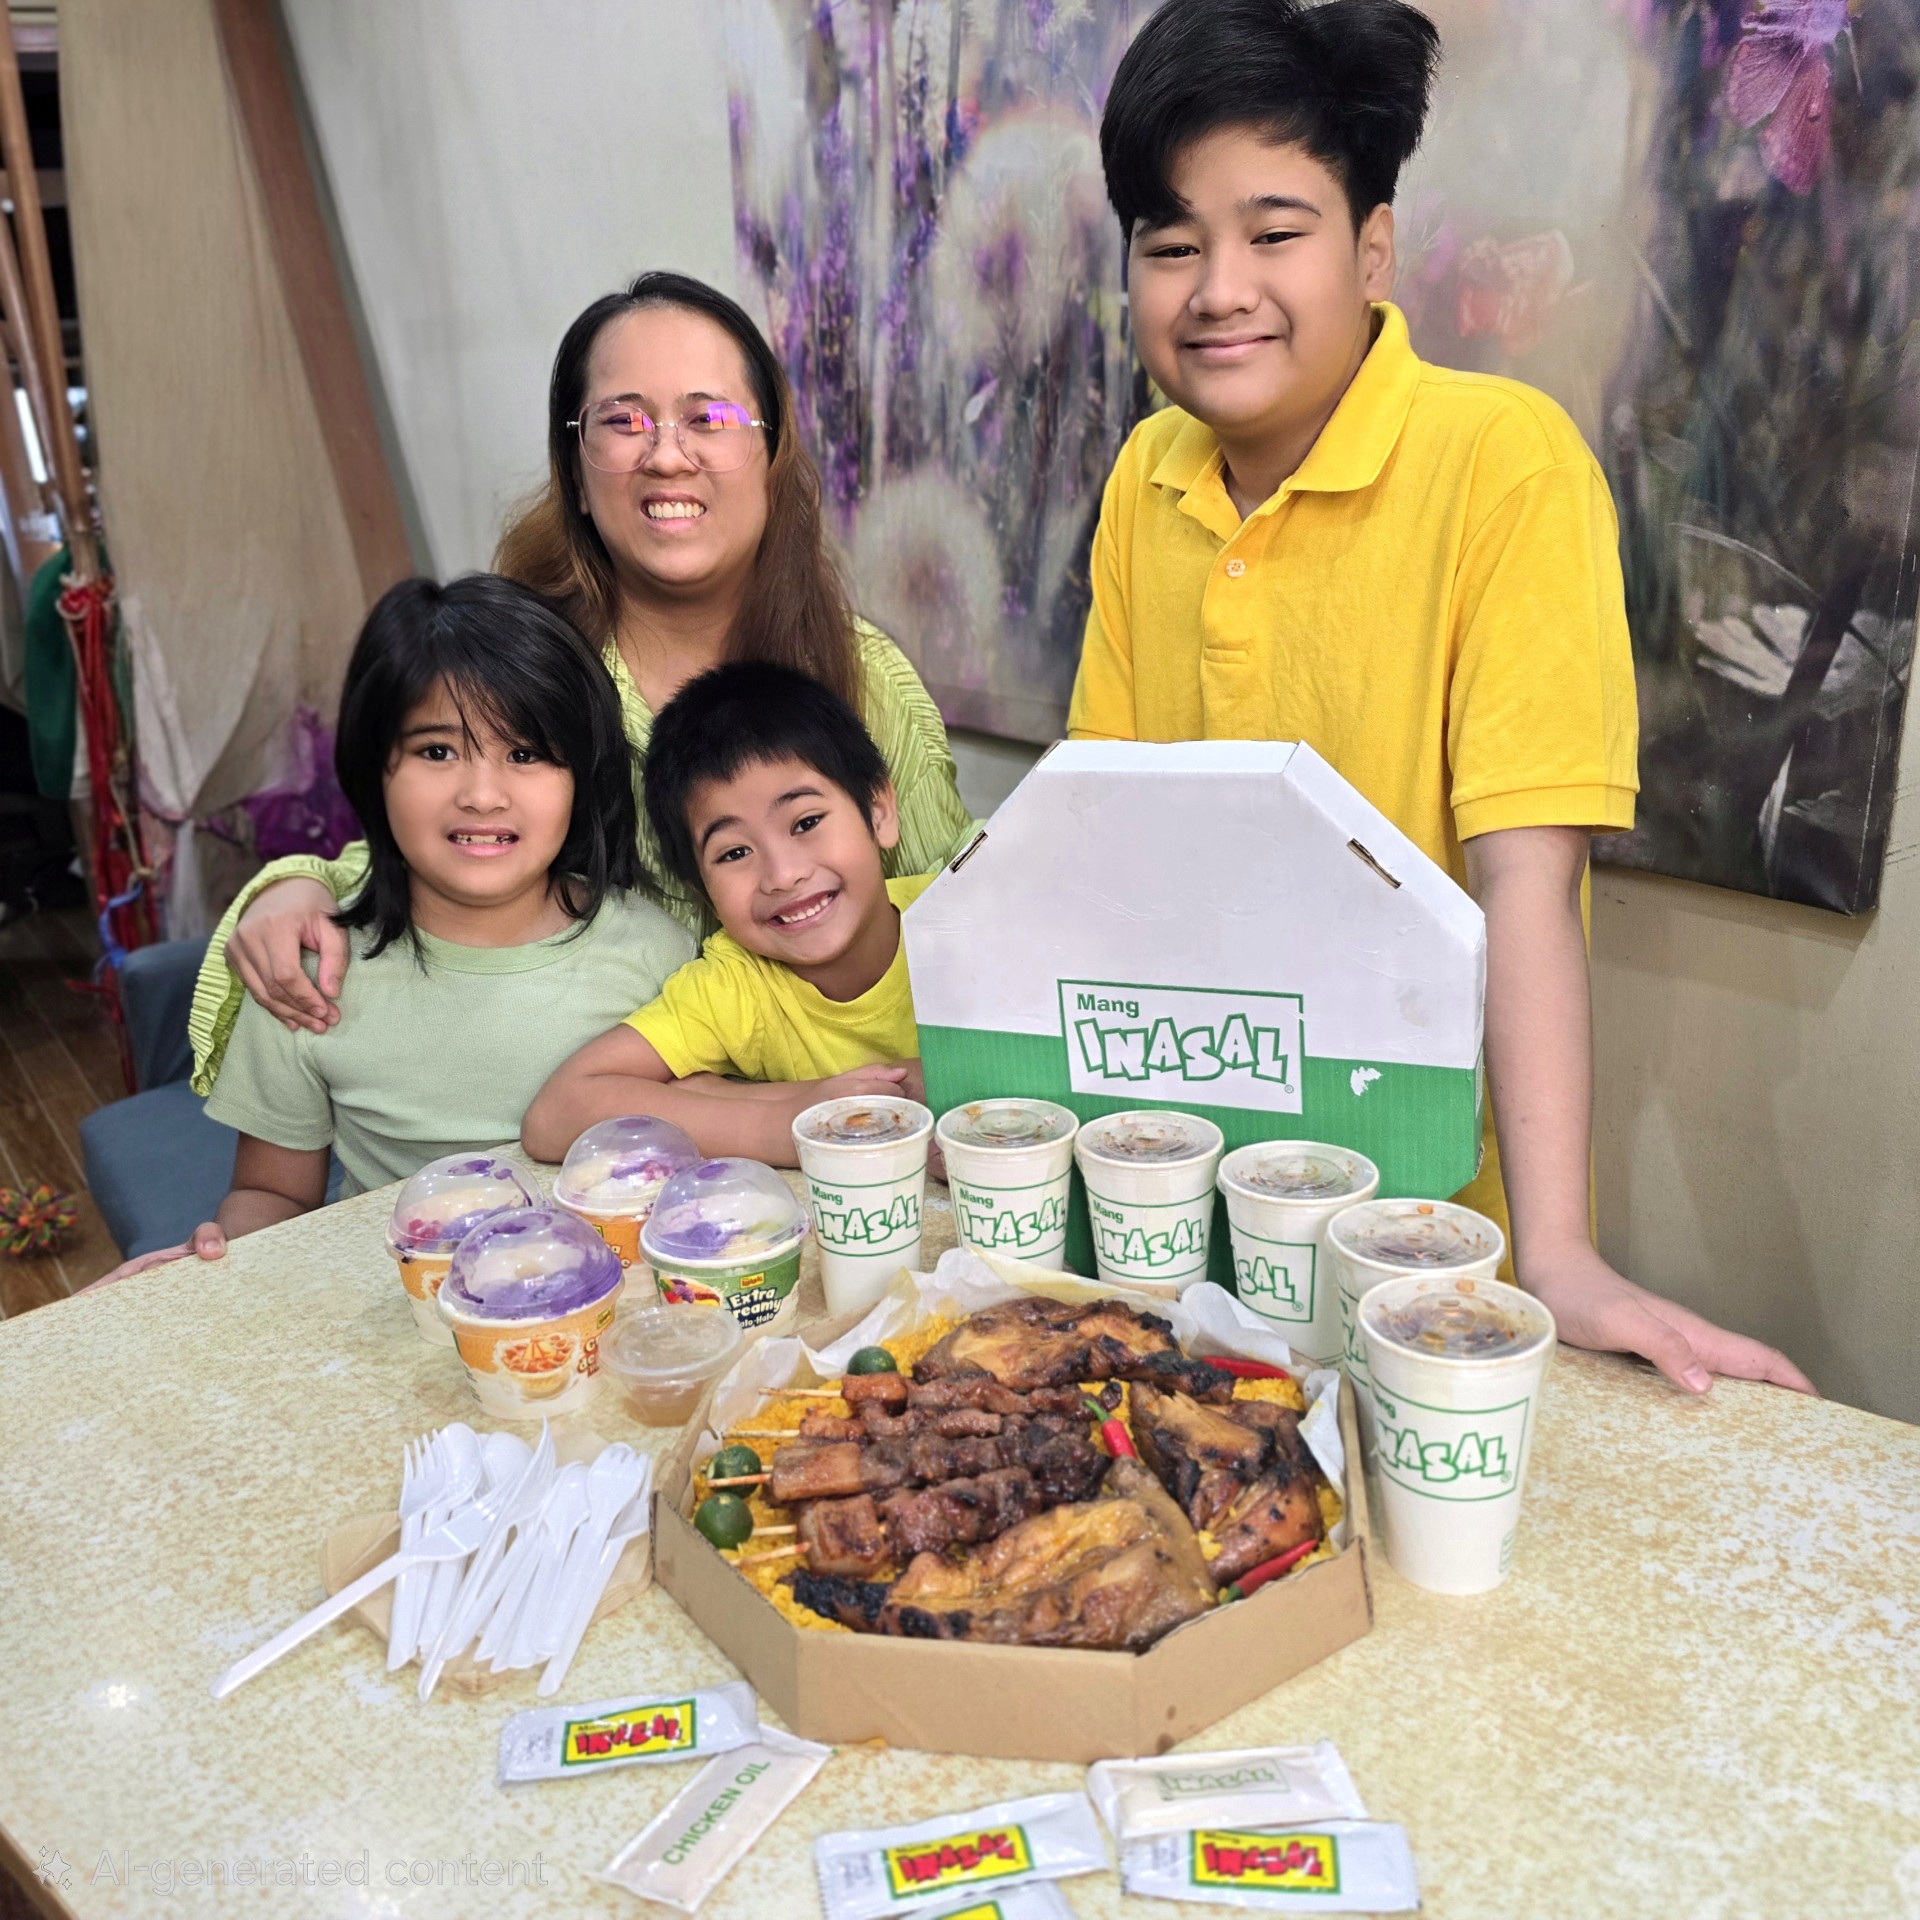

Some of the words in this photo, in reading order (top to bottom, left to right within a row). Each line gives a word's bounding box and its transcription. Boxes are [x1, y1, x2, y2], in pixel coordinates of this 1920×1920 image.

[1076, 993, 1140, 1018] Mang
[1074, 1013, 1288, 1085] INASAL
[811, 1184, 843, 1206] Mang
[960, 1187, 994, 1209] Mang
[811, 1194, 919, 1244] INASAL
[959, 1197, 1065, 1248] INASAL
[1093, 1217, 1204, 1267] INASAL
[728, 1287, 776, 1309] Extra
[1236, 1256, 1296, 1303] SAL
[732, 1299, 783, 1320] reamy
[739, 1312, 775, 1329] alo-Halo
[1377, 1417, 1508, 1483] NASAL
[661, 1787, 743, 1867] CHICKEN
[734, 1758, 771, 1786] OIL
